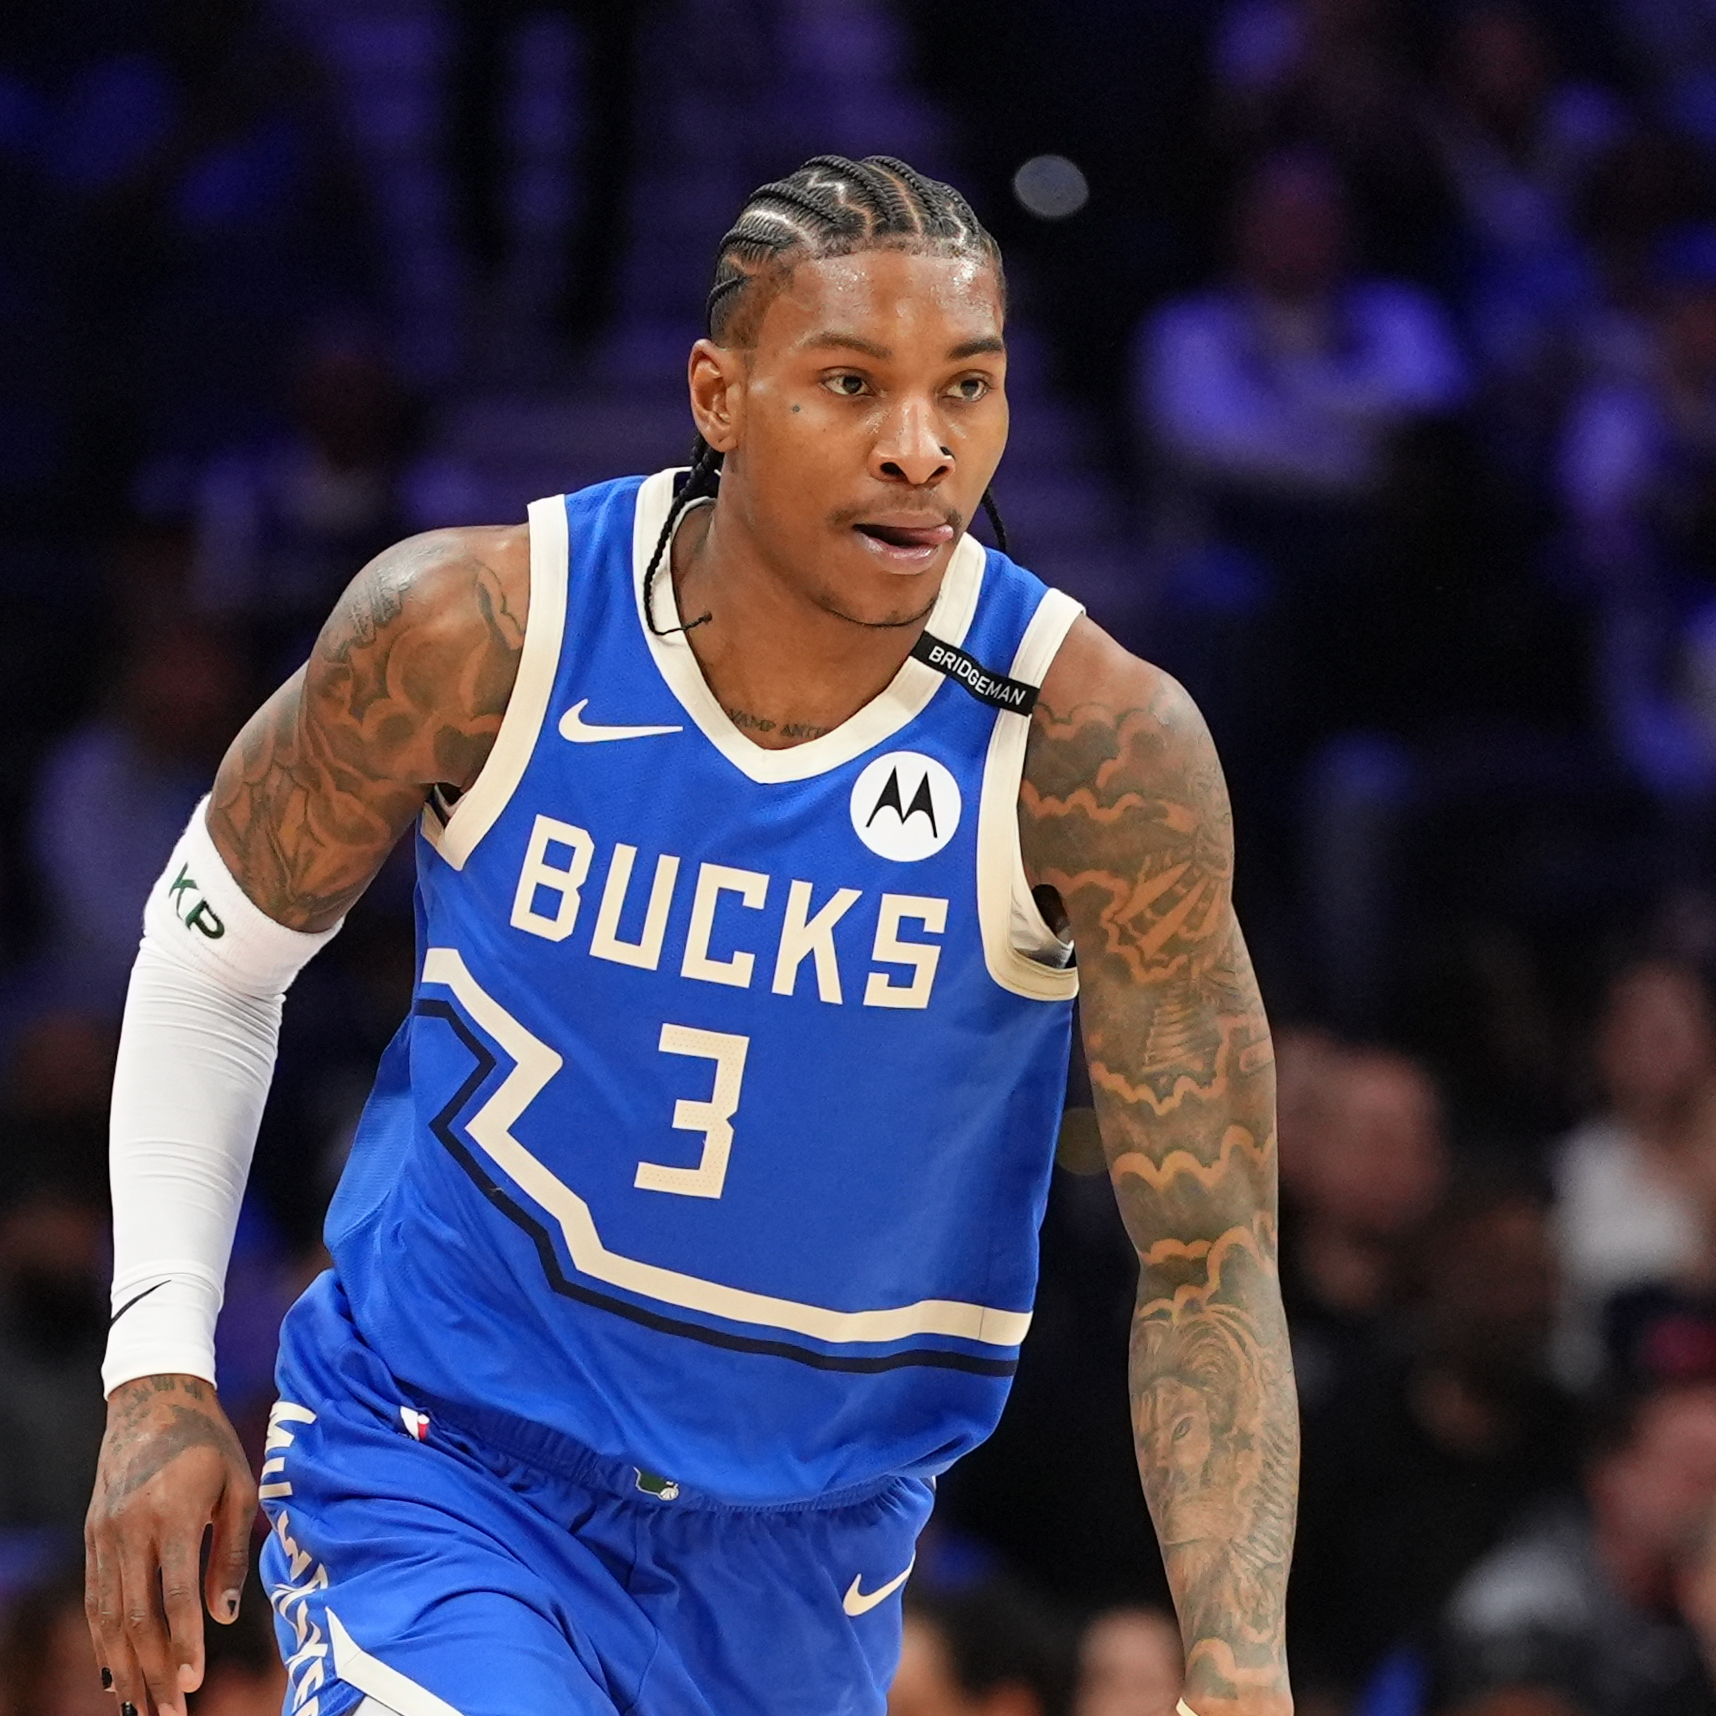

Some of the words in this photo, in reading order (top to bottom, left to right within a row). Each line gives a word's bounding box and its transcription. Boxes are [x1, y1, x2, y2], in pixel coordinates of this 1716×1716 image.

[928, 646, 1027, 706] BRIDGEMAN
[168, 860, 225, 940] KP
[509, 813, 949, 1010] BUCKS
[632, 1022, 750, 1200] 3
